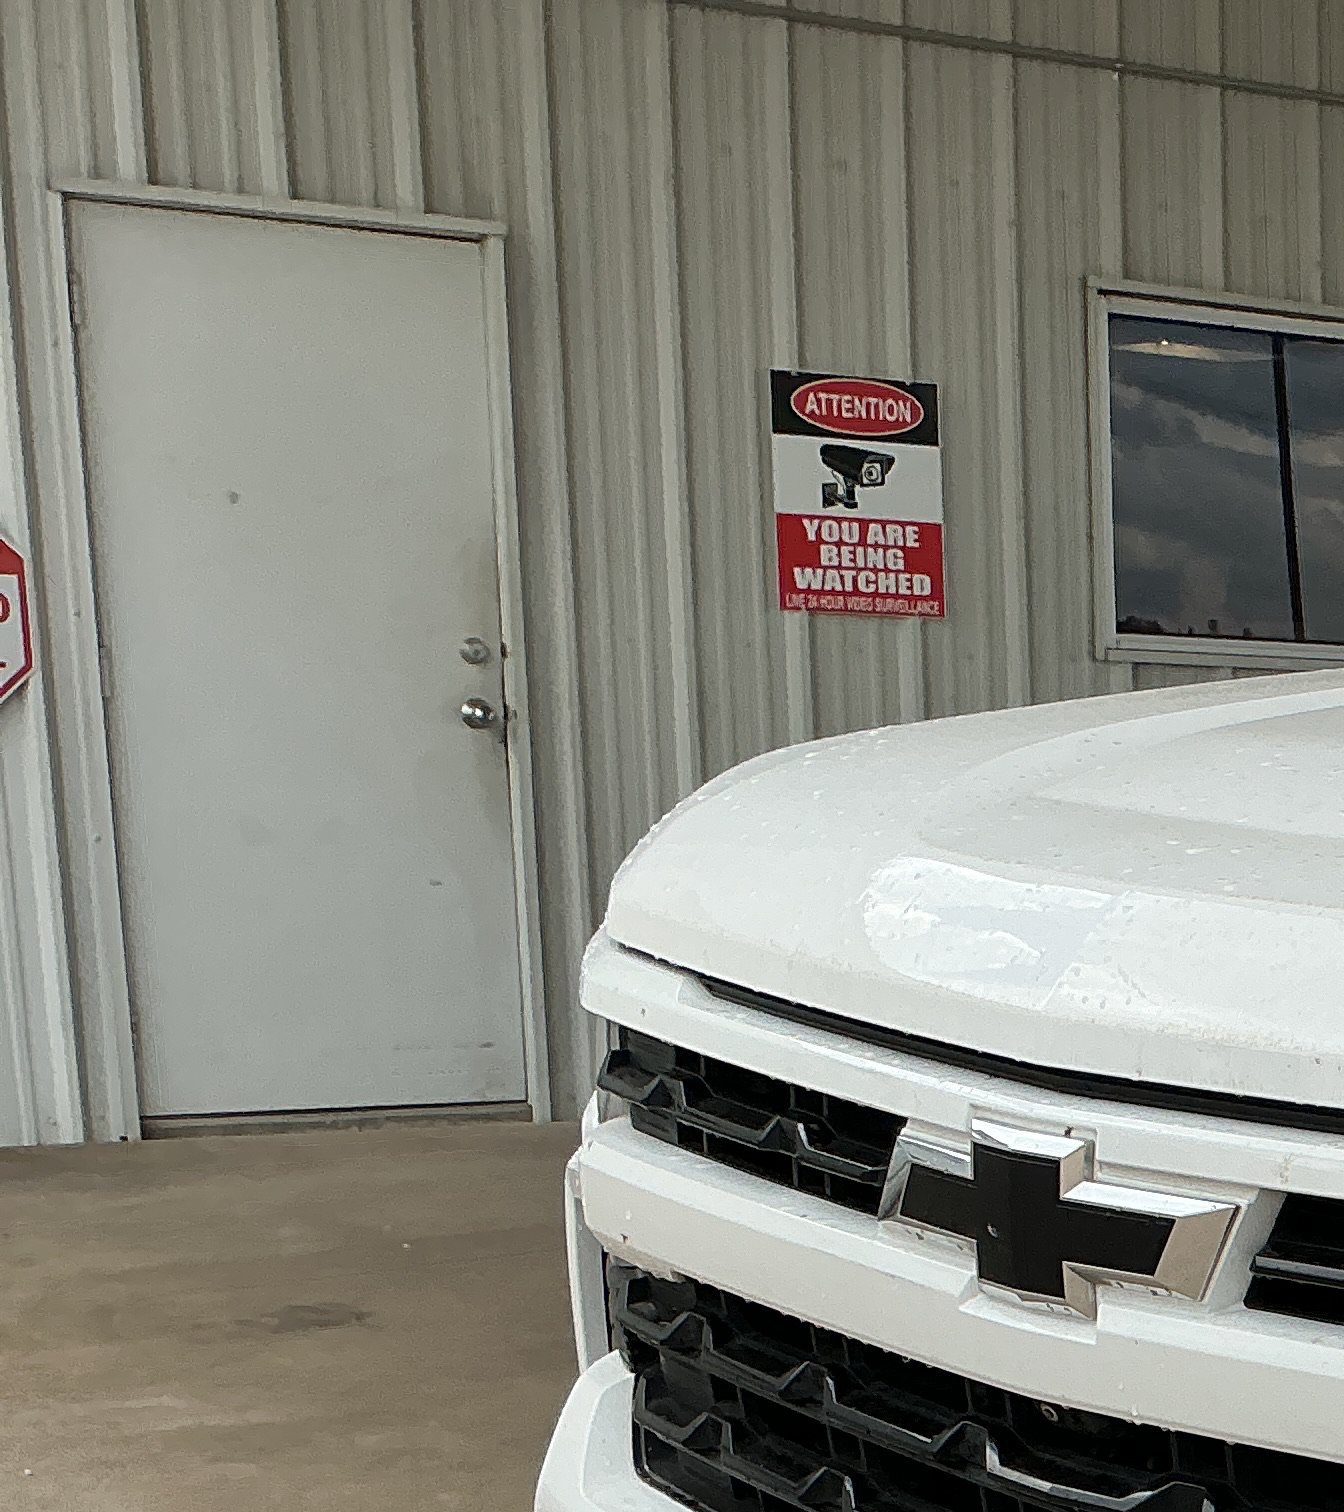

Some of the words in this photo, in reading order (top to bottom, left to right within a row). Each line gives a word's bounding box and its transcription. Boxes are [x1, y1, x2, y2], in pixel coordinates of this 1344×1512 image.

[804, 391, 911, 424] ATTENTION
[802, 518, 860, 543] YOU
[866, 523, 920, 548] ARE
[820, 544, 905, 571] BEING
[794, 567, 932, 596] WATCHED
